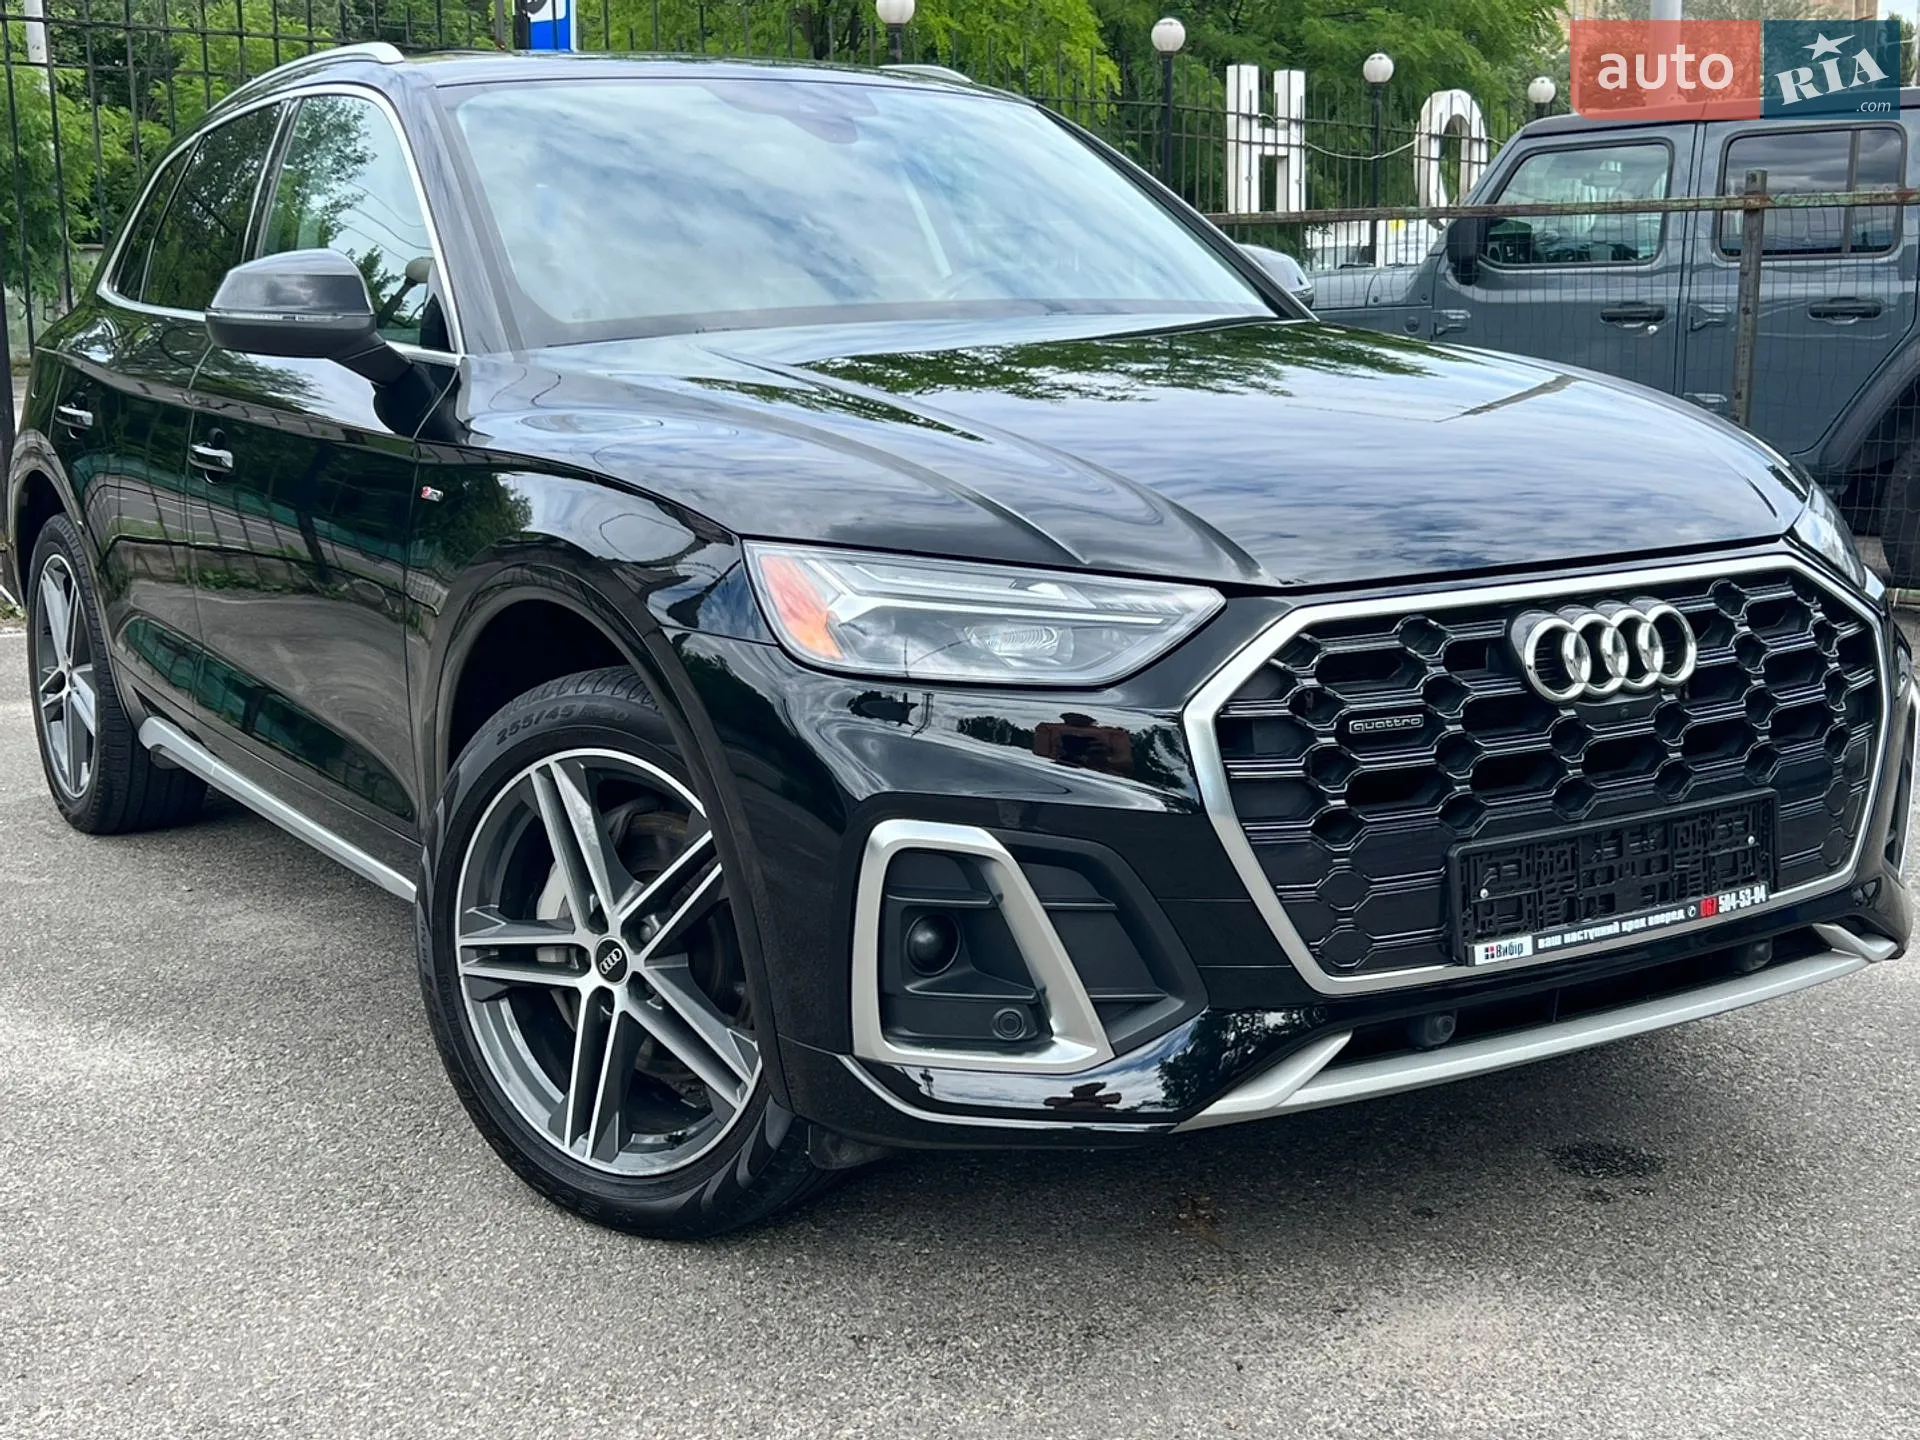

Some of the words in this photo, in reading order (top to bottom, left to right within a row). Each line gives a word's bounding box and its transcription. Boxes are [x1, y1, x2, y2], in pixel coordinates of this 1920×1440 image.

[496, 704, 578, 746] 255/45
[1353, 717, 1421, 733] quattro
[1496, 942, 1524, 958] Вибір
[1718, 885, 1766, 913] 504-53-04
